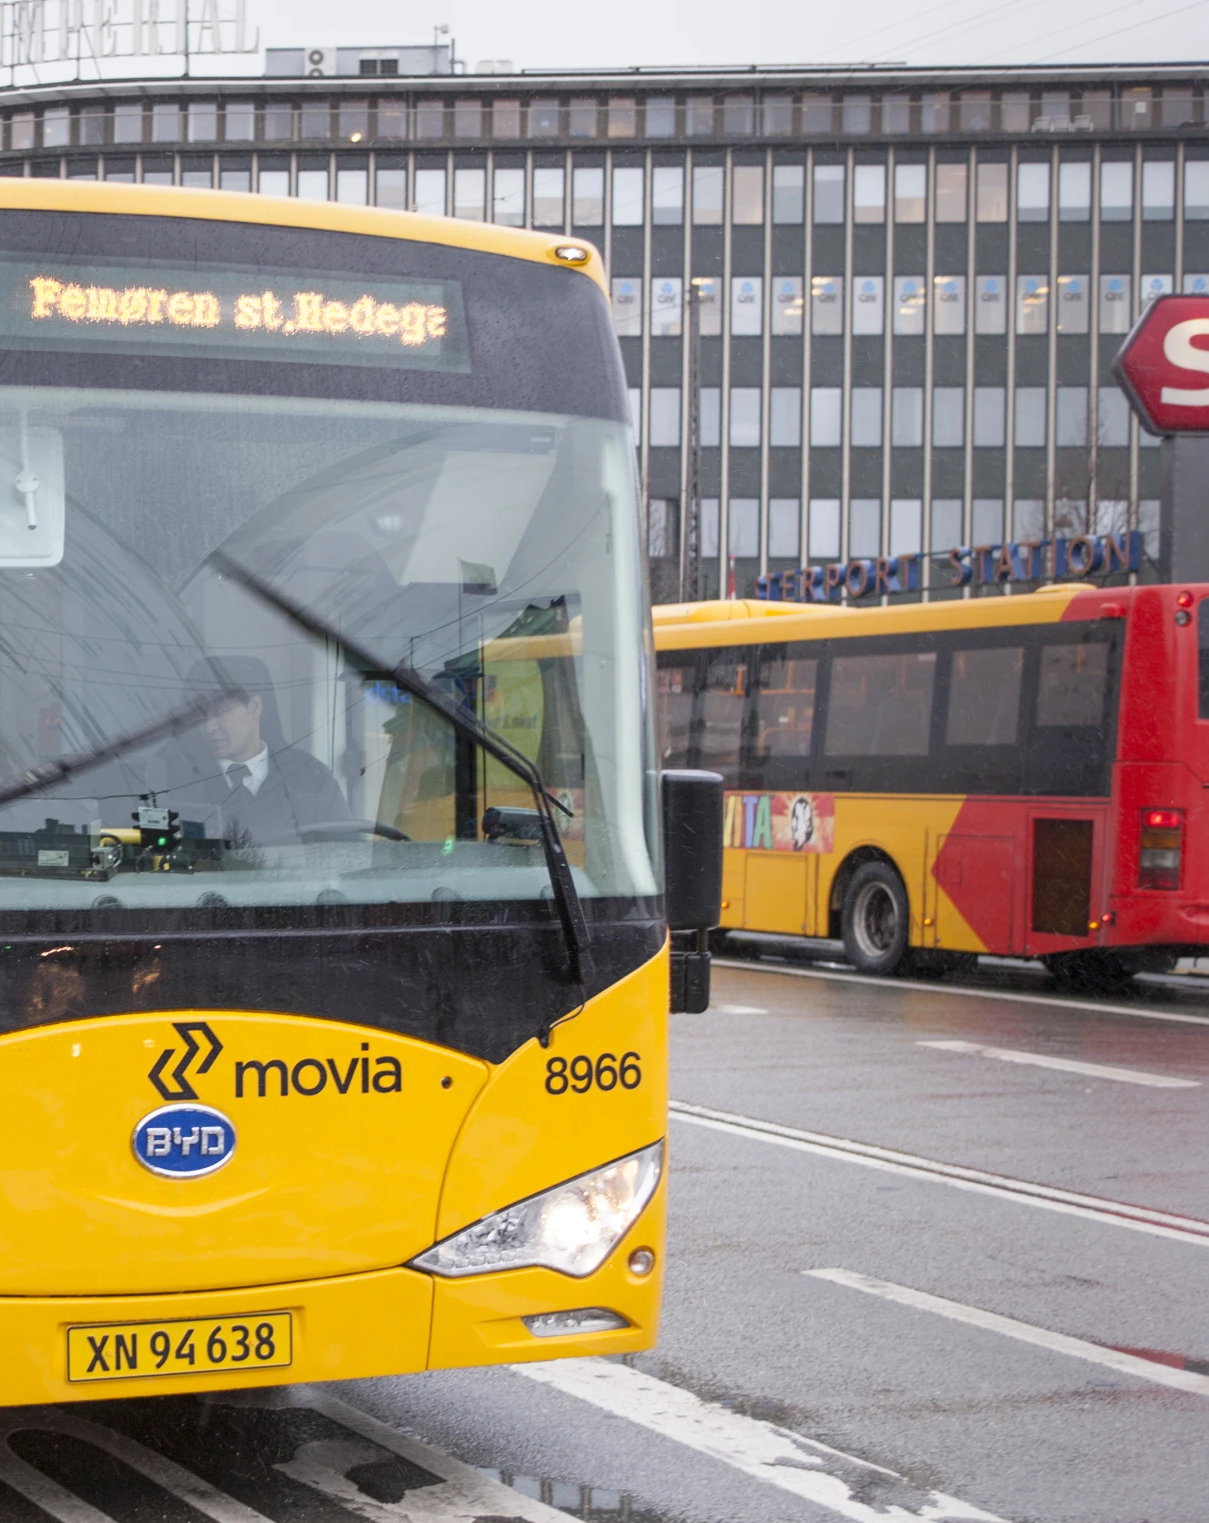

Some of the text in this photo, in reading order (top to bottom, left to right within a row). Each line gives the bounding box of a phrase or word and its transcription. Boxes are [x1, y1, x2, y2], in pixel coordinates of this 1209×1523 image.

[1161, 318, 1209, 407] S
[949, 531, 1140, 586] STATION
[235, 1042, 402, 1098] movia
[545, 1051, 642, 1095] 8966
[146, 1126, 225, 1157] BYD
[86, 1321, 276, 1372] XN 94 638
